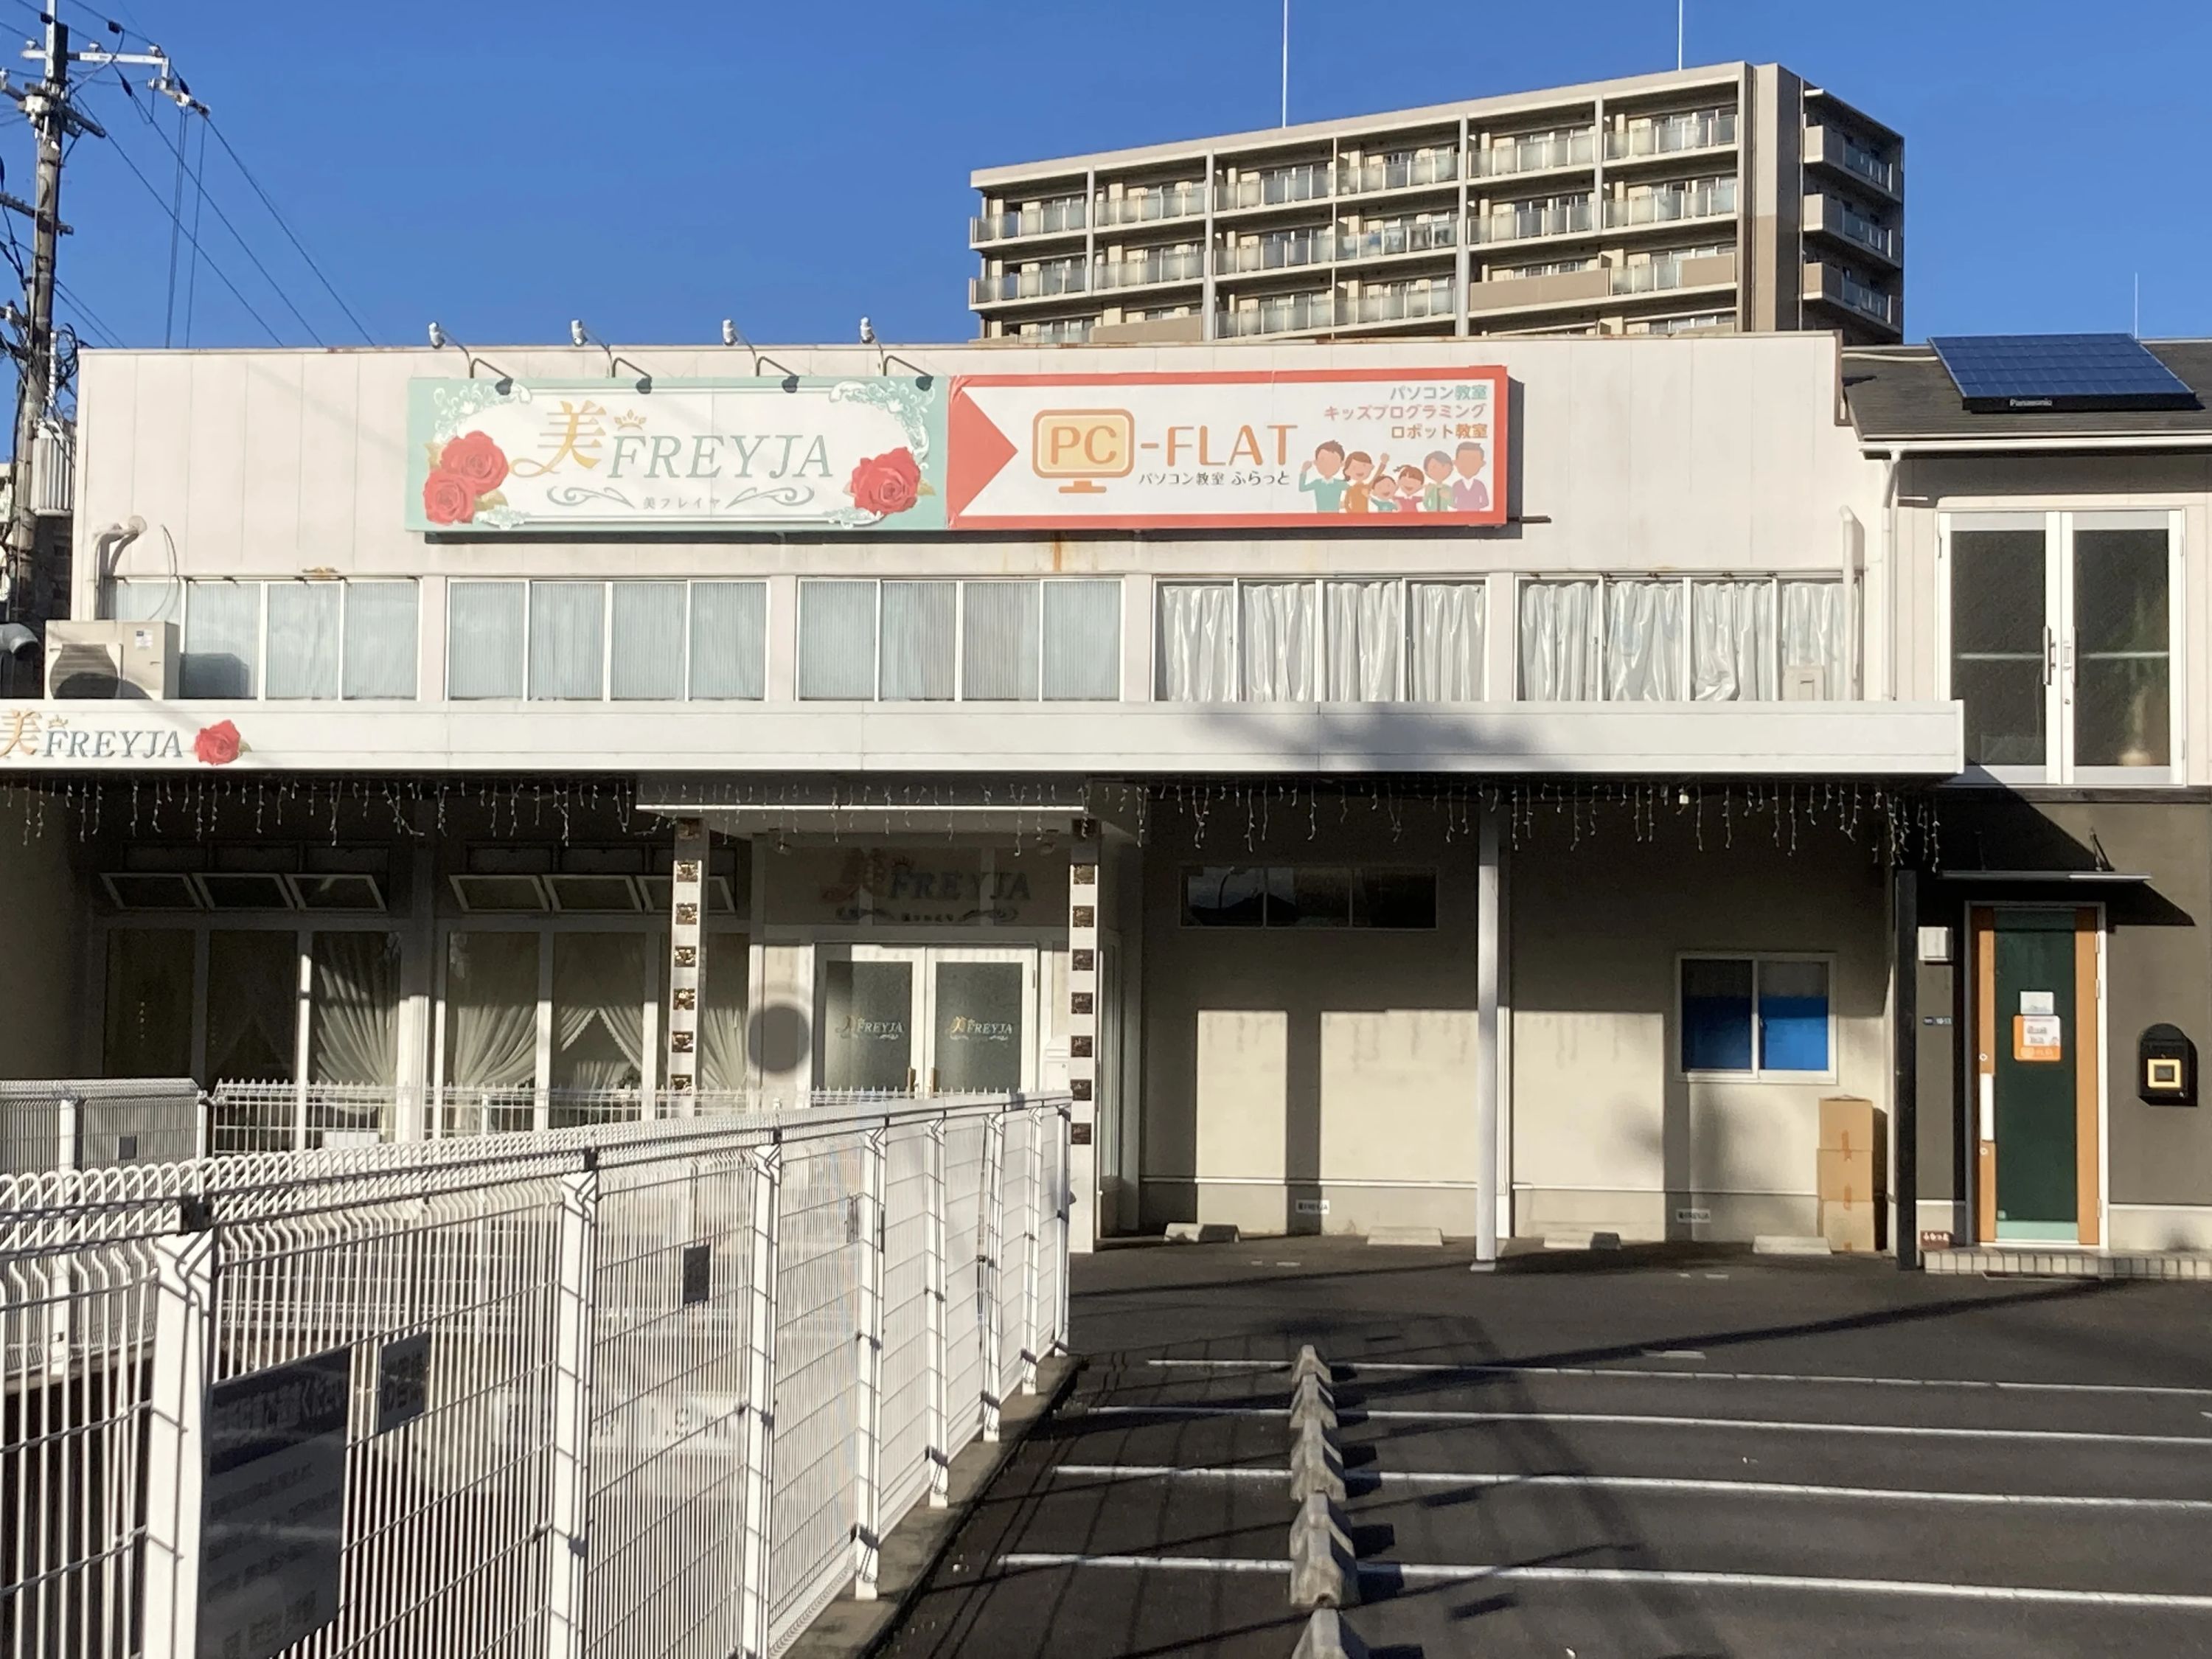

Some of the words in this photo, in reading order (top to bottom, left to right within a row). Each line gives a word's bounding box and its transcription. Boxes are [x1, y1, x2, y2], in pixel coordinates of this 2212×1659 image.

[1390, 384, 1488, 401] パソコン教室
[2010, 398, 2052, 406] Panasonic
[1324, 403, 1487, 421] キッズプログラミング
[1391, 422, 1488, 439] ロボット教室
[509, 400, 607, 478] 美
[607, 435, 833, 479] FREYJA
[1138, 472, 1225, 486] パソコン教室
[1231, 470, 1290, 485] ふらっと
[43, 730, 184, 758] FREYJA
